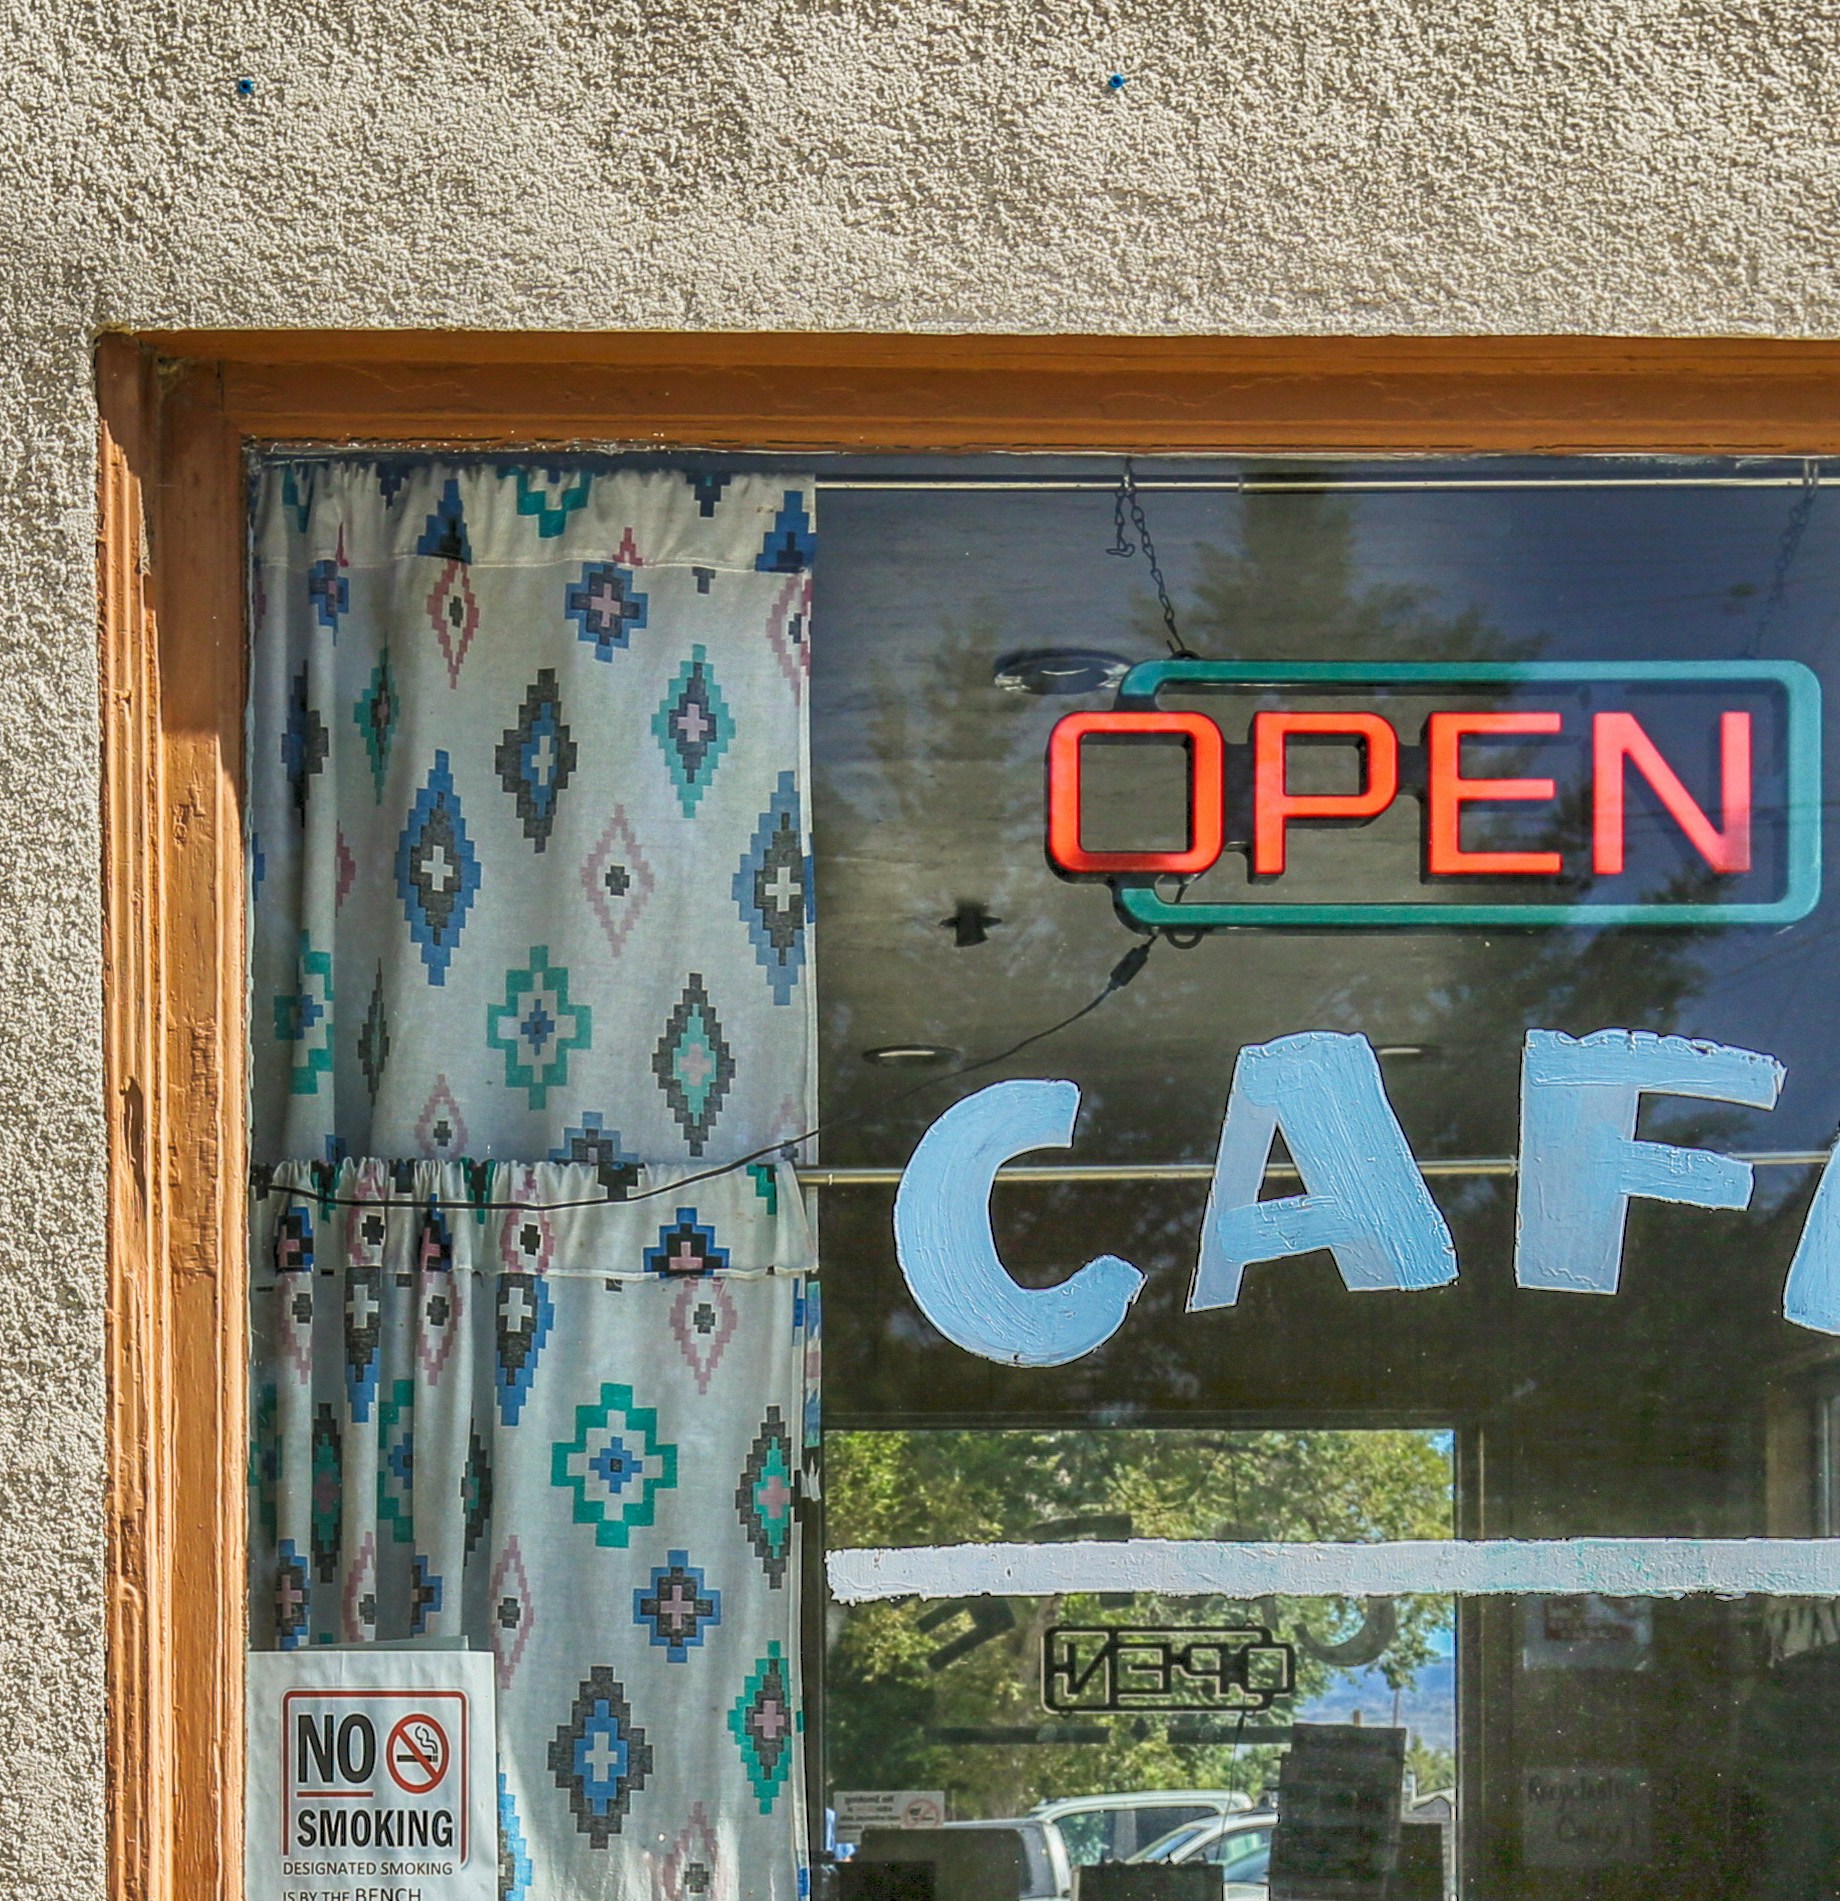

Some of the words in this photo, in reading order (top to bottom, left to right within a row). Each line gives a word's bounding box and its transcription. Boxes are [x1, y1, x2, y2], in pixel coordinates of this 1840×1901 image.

[1048, 710, 1752, 876] OPEN
[297, 1713, 376, 1784] NO
[296, 1809, 454, 1848] SMOKING
[282, 1861, 377, 1876] DESIGNATED
[380, 1861, 453, 1876] SMOKING
